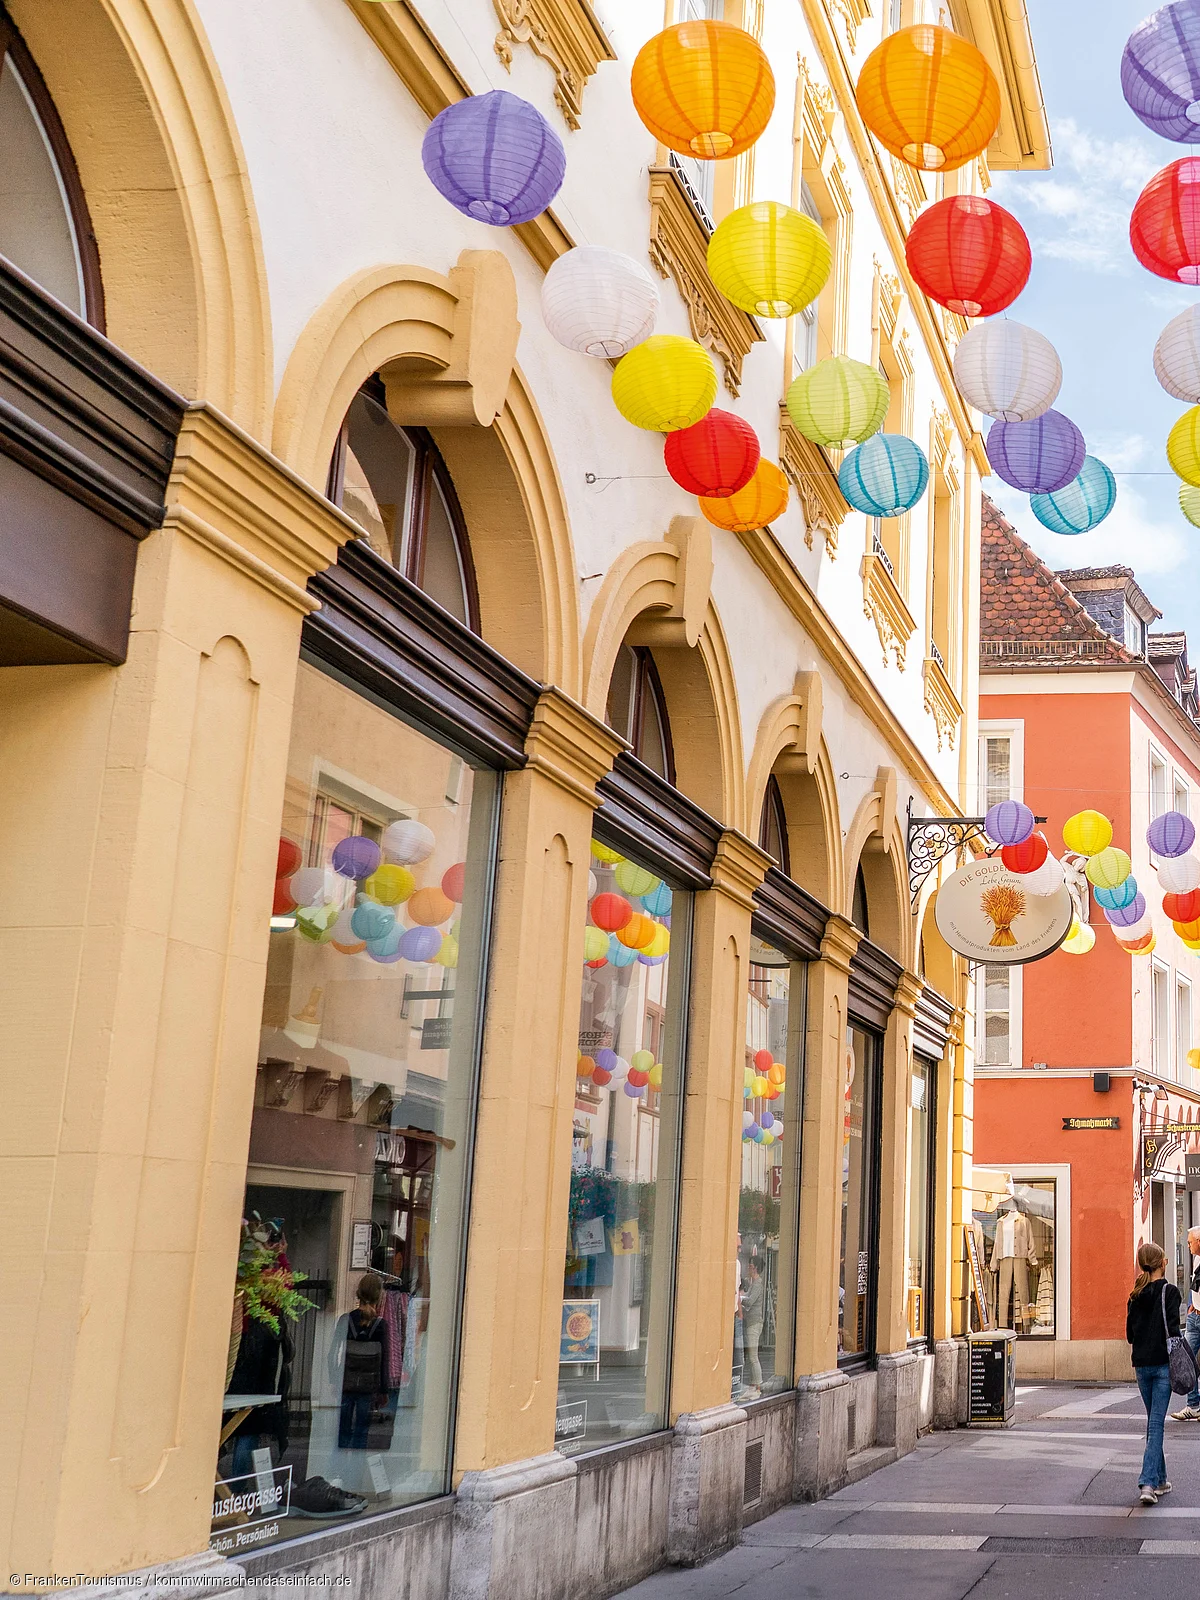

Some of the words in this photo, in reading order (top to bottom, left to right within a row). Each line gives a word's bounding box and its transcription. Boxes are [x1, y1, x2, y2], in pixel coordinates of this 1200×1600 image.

[959, 875, 974, 887] DIE
[955, 929, 1000, 953] Heimatprodukten
[1016, 942, 1031, 951] Land
[1031, 937, 1041, 946] des
[1041, 917, 1057, 939] Friedens
[236, 1522, 279, 1547] Persönlich
